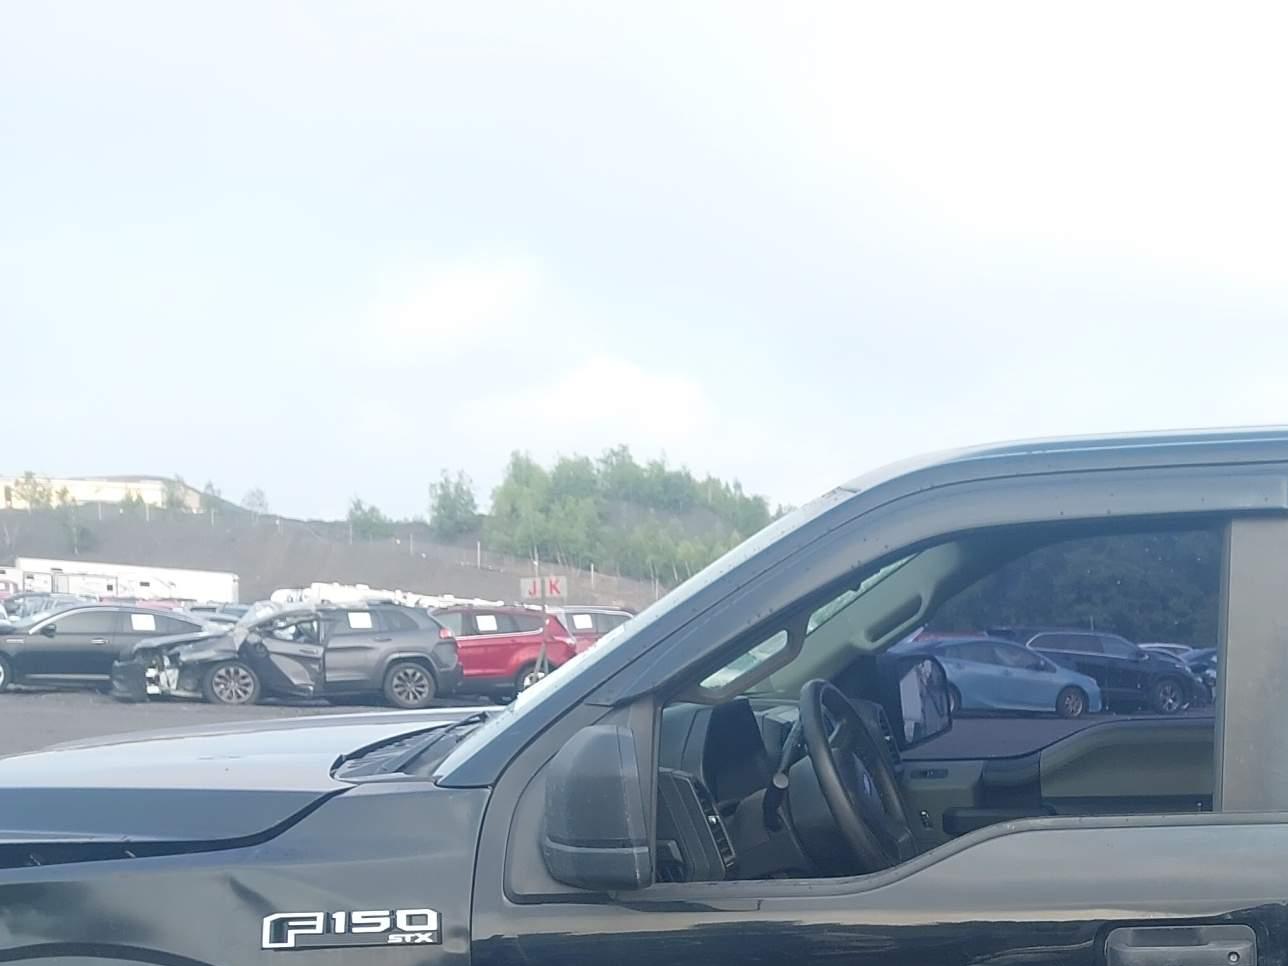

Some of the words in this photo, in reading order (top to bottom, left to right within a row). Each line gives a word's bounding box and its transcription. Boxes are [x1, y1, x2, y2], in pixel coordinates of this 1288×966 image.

[528, 580, 536, 595] J
[549, 580, 560, 594] K
[387, 932, 433, 944] STX
